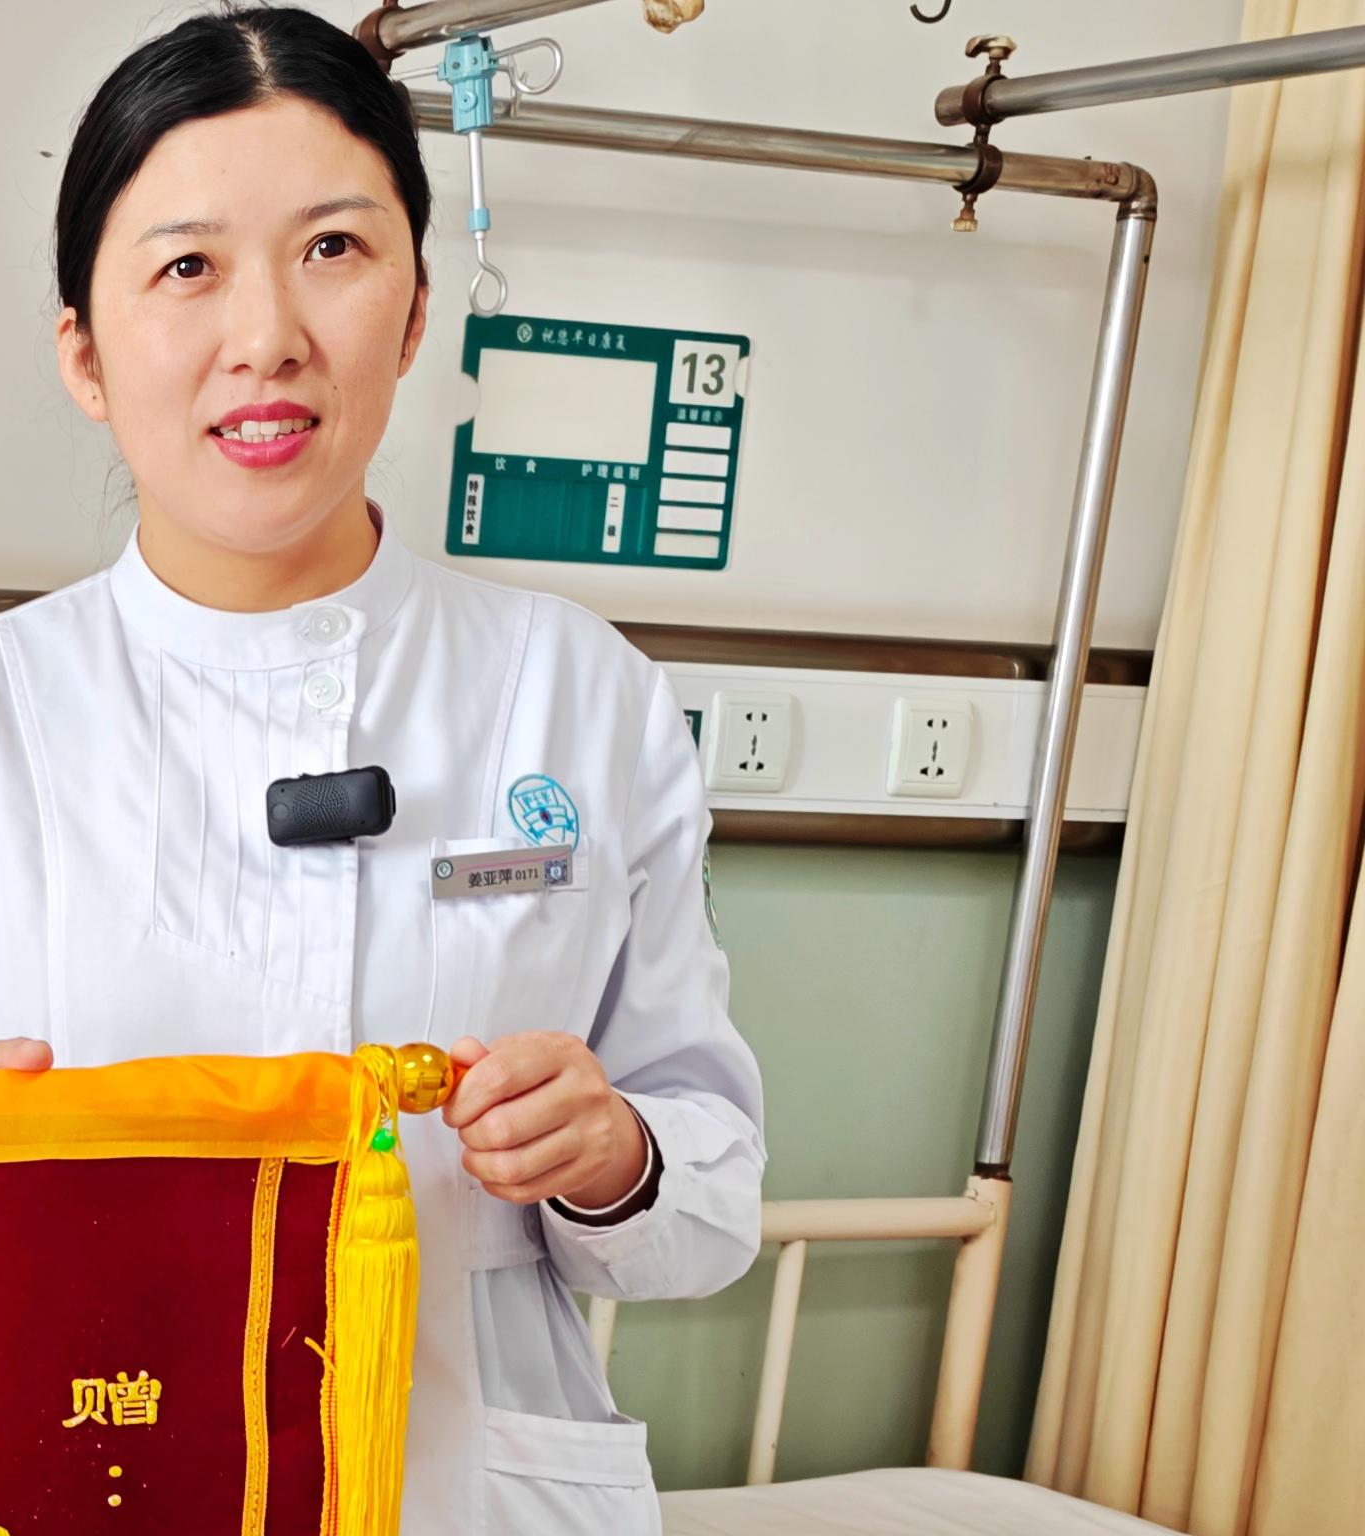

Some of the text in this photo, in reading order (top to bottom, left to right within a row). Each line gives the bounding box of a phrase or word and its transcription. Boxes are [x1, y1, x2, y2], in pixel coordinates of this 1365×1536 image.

[542, 327, 626, 352] 祝您早日康复
[682, 352, 726, 396] 13
[515, 867, 539, 881] 0171
